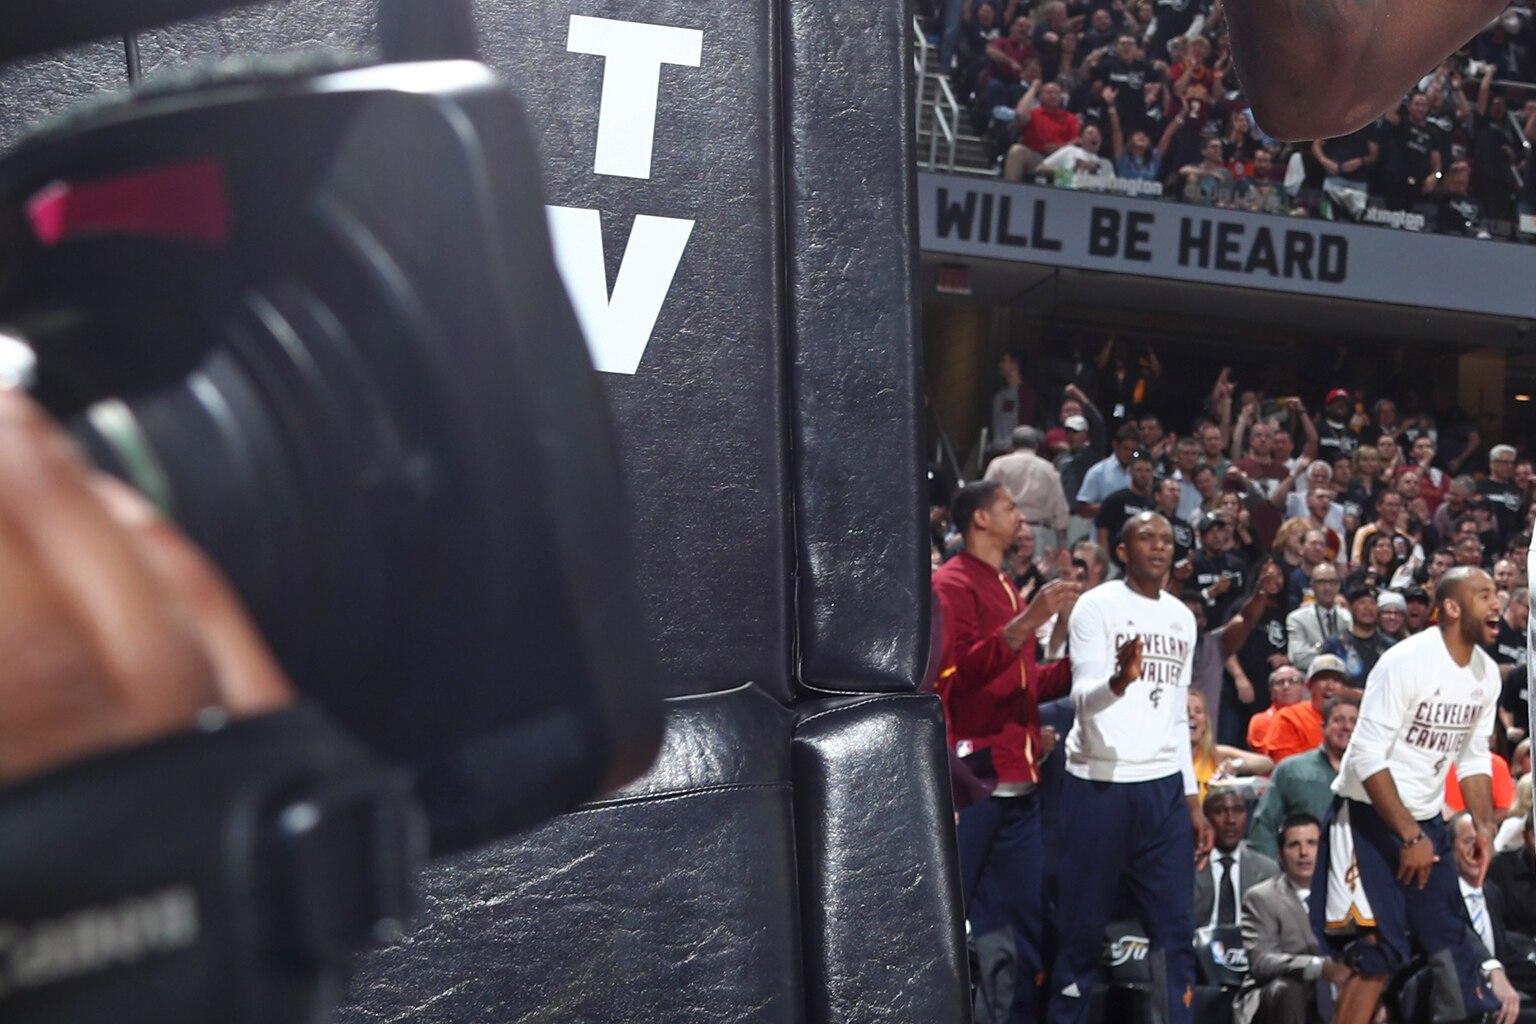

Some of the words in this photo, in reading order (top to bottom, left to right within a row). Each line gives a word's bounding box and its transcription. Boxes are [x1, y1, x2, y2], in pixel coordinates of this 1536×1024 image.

[936, 187, 1063, 252] WILL
[1089, 206, 1155, 262] BE
[1178, 217, 1348, 284] HEARD
